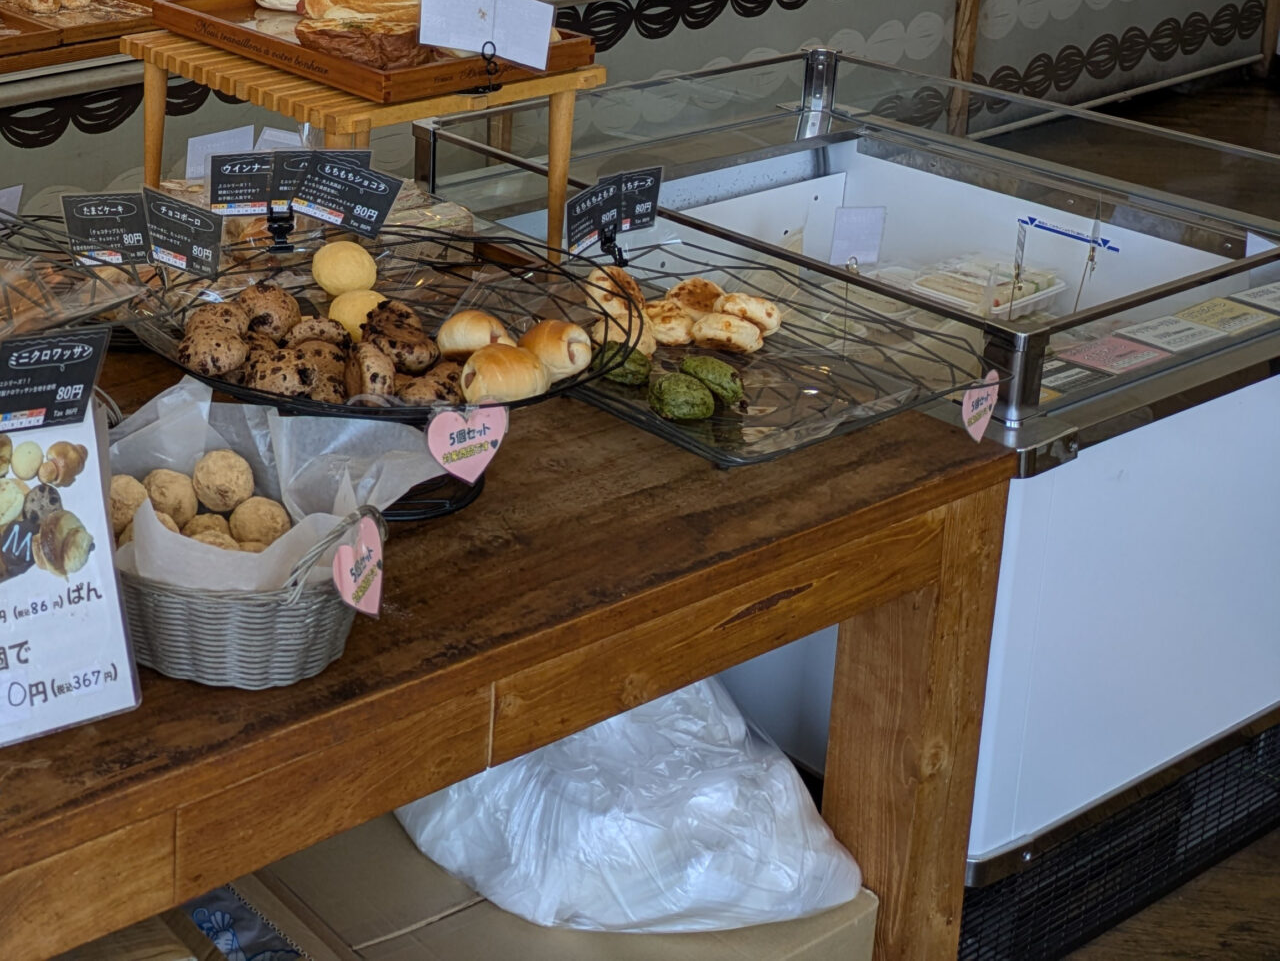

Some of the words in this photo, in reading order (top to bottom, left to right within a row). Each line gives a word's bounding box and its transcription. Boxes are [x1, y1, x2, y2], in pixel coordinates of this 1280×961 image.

[324, 165, 387, 191] もちもちショコラ
[82, 204, 125, 215] たまごケーキ
[353, 204, 379, 223] 80円
[634, 201, 653, 214] 80円
[123, 232, 144, 246] 80円
[192, 244, 213, 261] 80円
[9, 345, 94, 365] ミニクロワッサン
[56, 384, 84, 400] 80円
[449, 423, 491, 446] 5個セット
